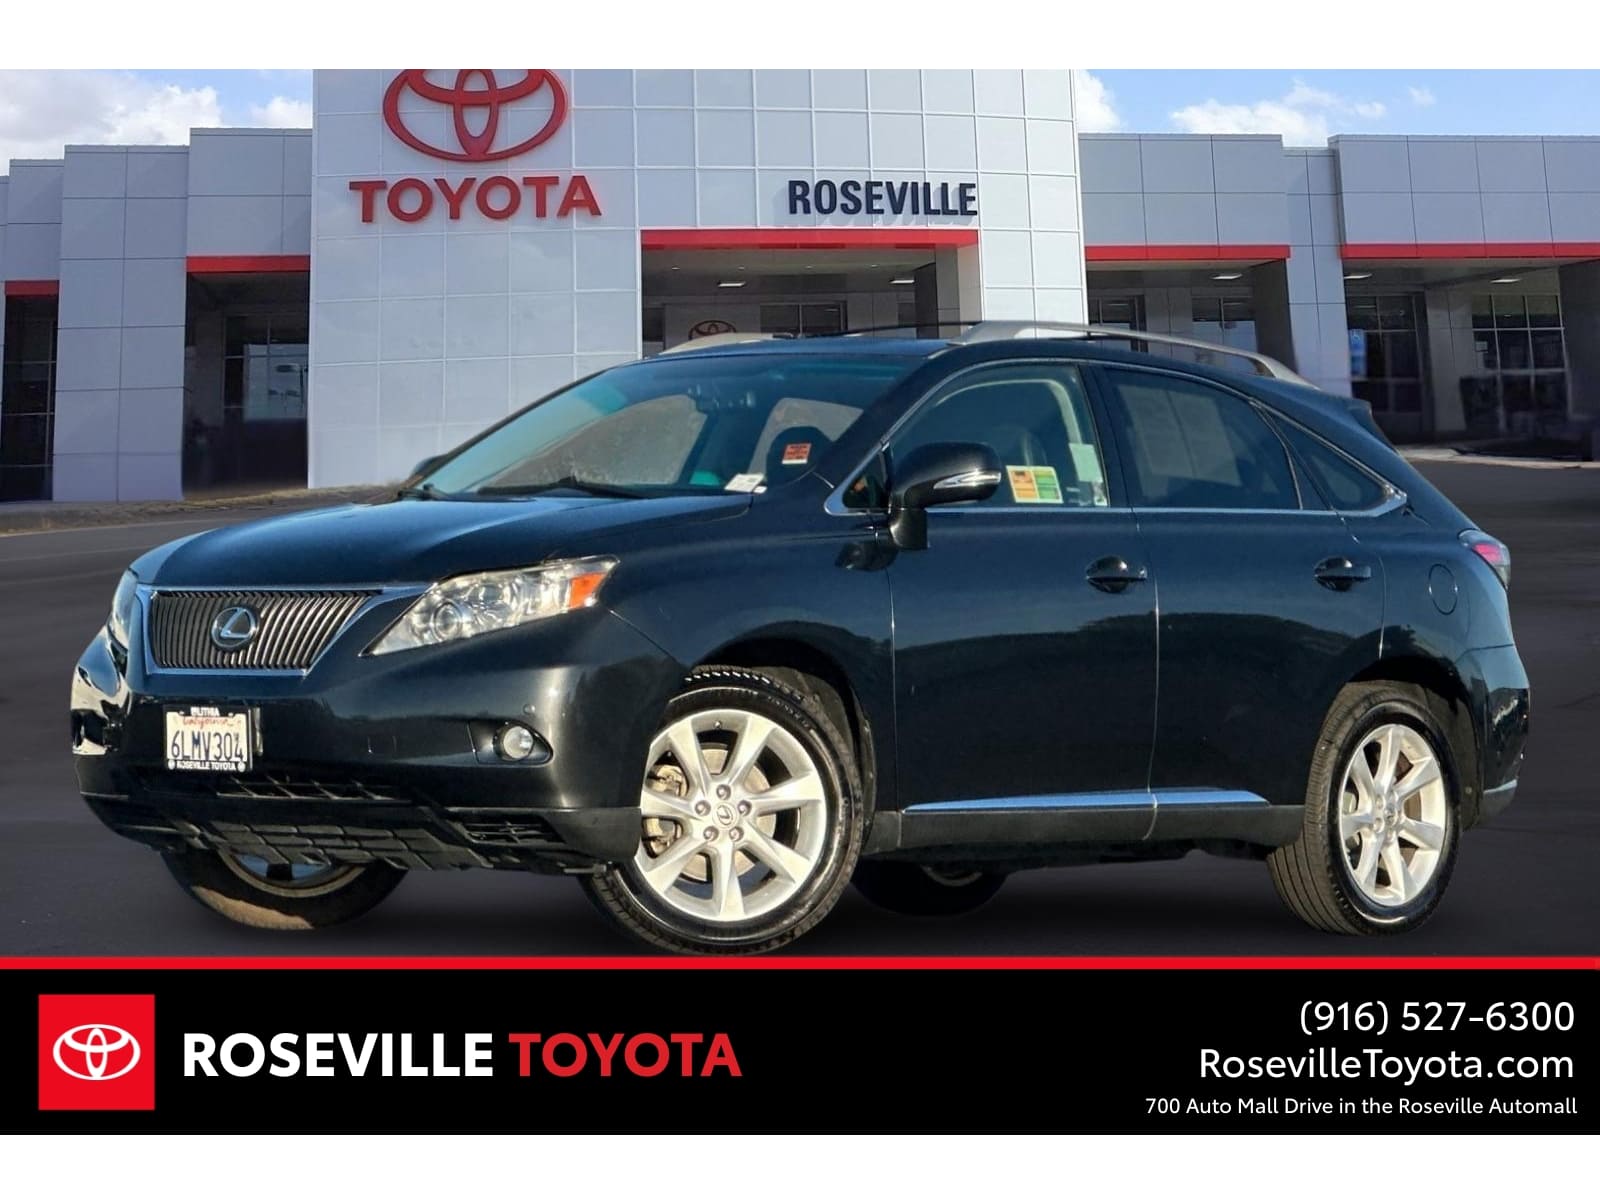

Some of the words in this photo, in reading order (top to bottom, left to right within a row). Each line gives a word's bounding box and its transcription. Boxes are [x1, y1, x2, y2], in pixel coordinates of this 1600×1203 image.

[349, 175, 601, 223] TOYOTA
[788, 180, 978, 216] ROSEVILLE
[171, 730, 243, 761] 6LMV304
[177, 760, 210, 770] ROSEVILLE
[211, 761, 236, 771] TOYOTA
